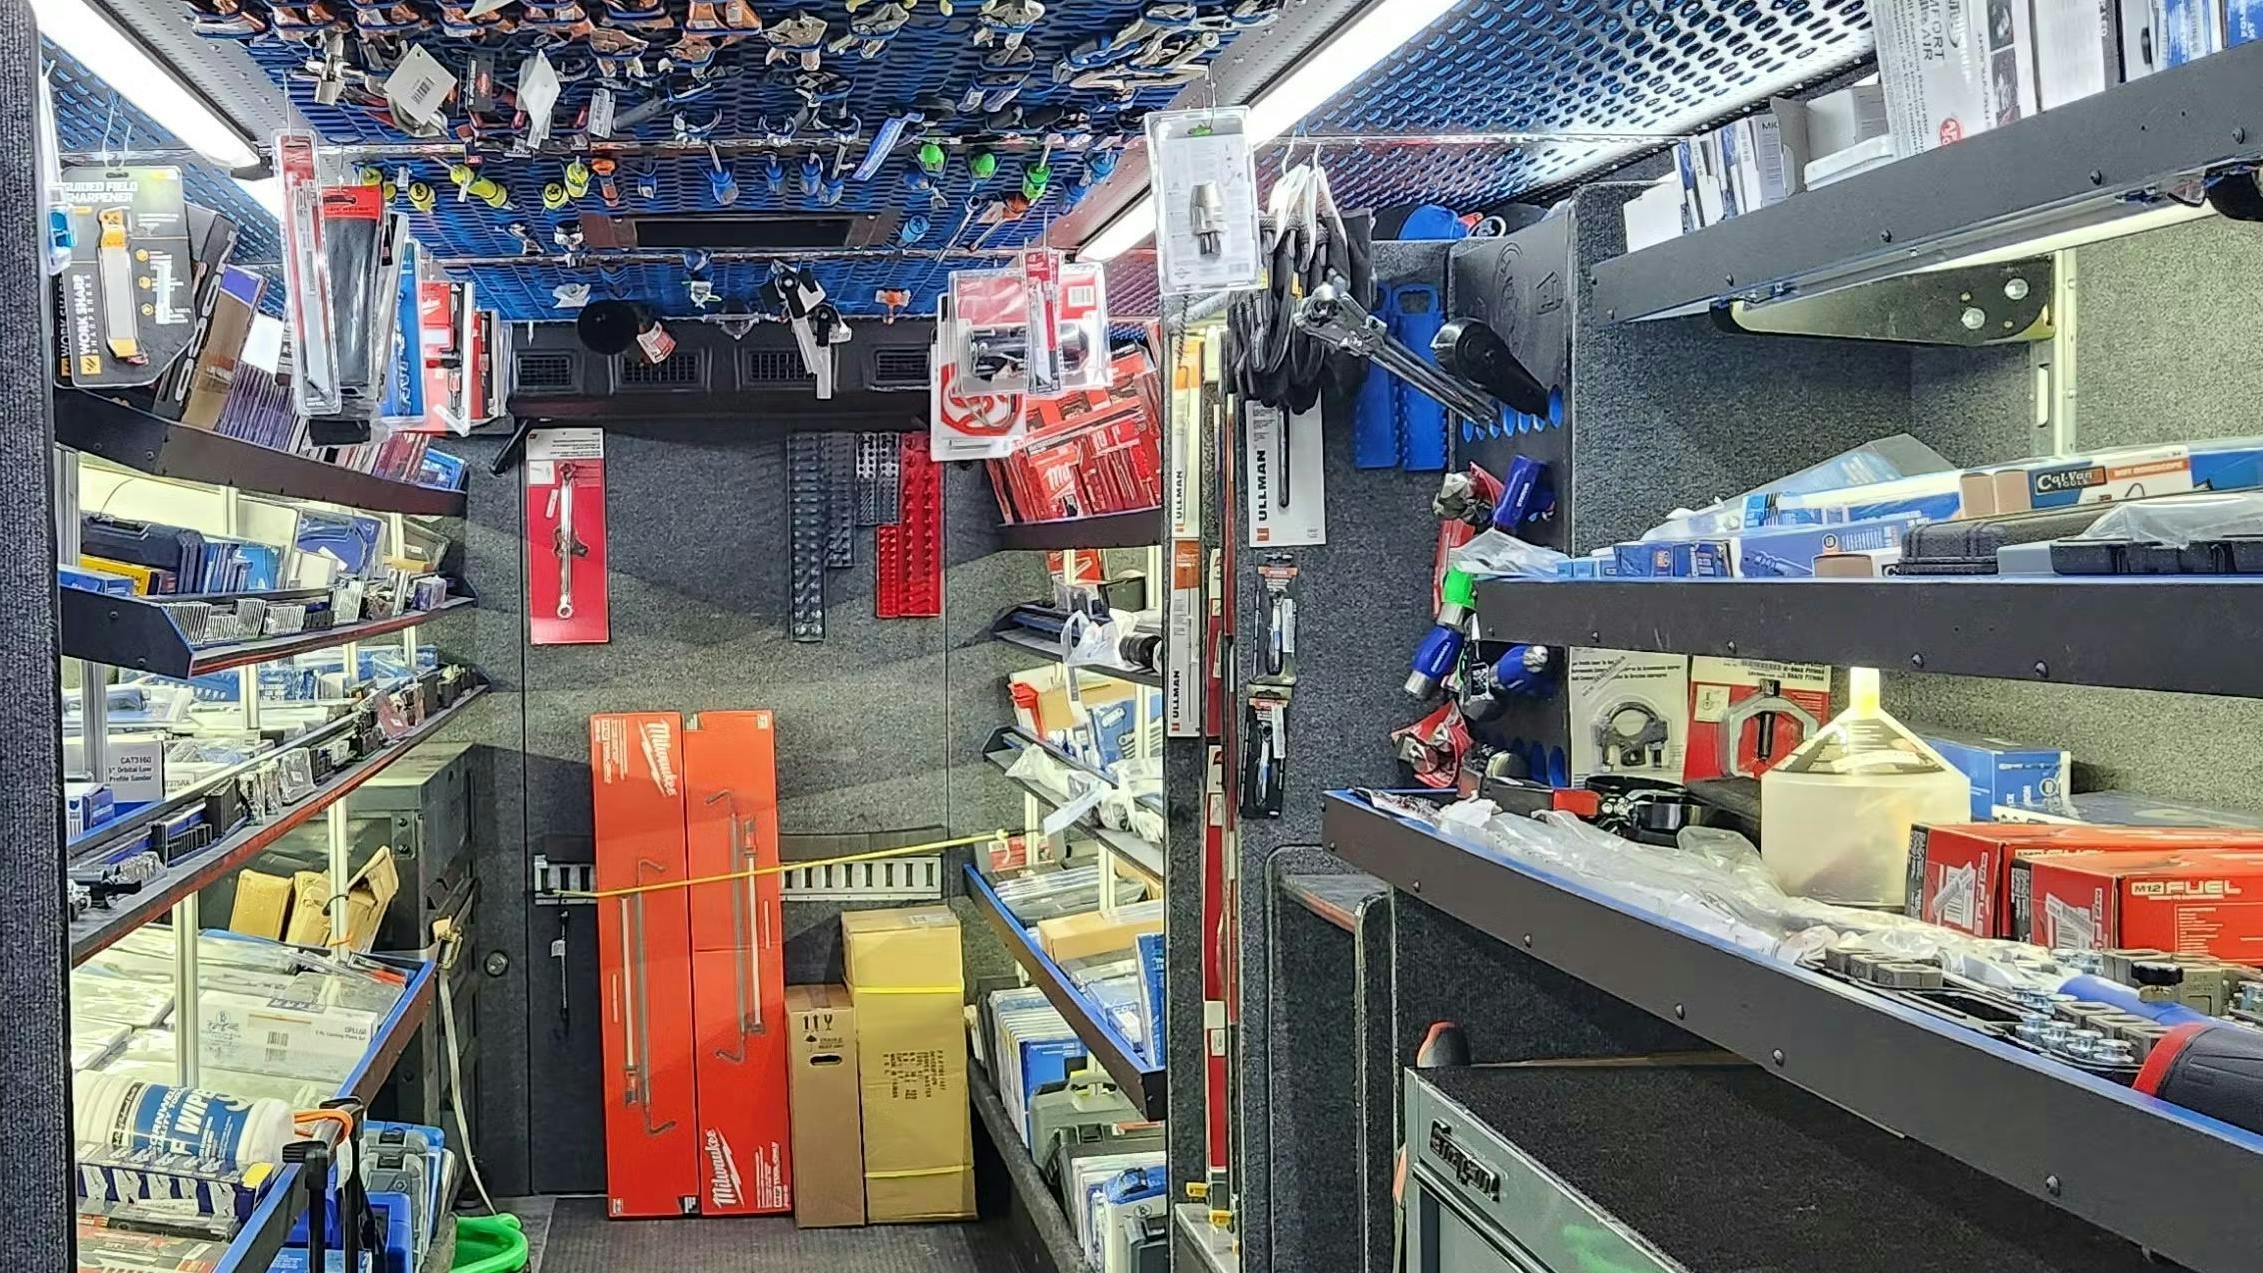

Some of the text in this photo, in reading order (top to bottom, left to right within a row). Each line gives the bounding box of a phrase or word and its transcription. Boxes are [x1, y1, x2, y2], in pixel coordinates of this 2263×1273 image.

[106, 181, 138, 192] FIELD
[72, 274, 90, 355] WORK SHARP
[1257, 450, 1267, 521] ULLMAN
[645, 720, 677, 796] Milwaukee
[2133, 880, 2242, 896] M12 FUEL
[704, 1129, 737, 1208] Milwaukee
